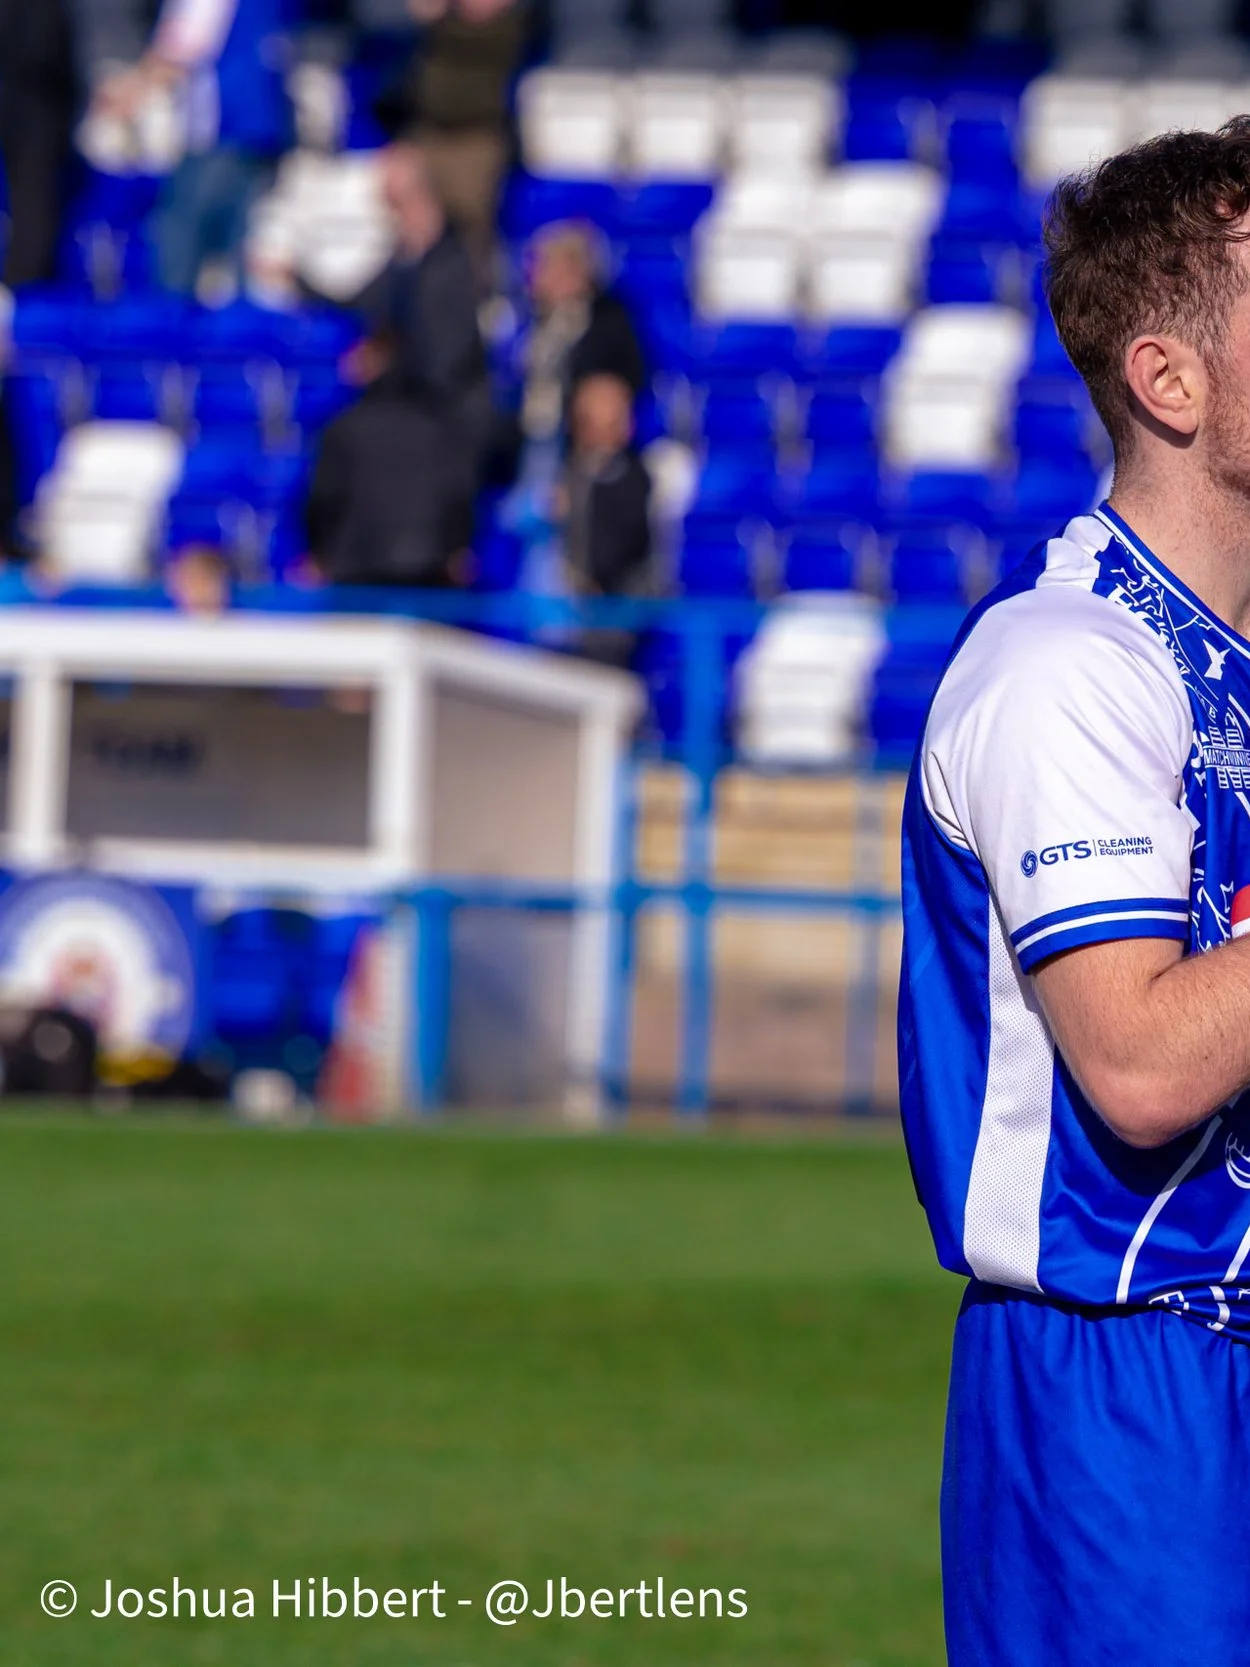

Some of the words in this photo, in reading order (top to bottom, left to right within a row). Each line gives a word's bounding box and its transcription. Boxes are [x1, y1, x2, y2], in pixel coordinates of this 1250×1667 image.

[1098, 837, 1153, 848] CLEANING
[1039, 840, 1092, 865] GTS
[1099, 846, 1154, 856] EQUIPMENT
